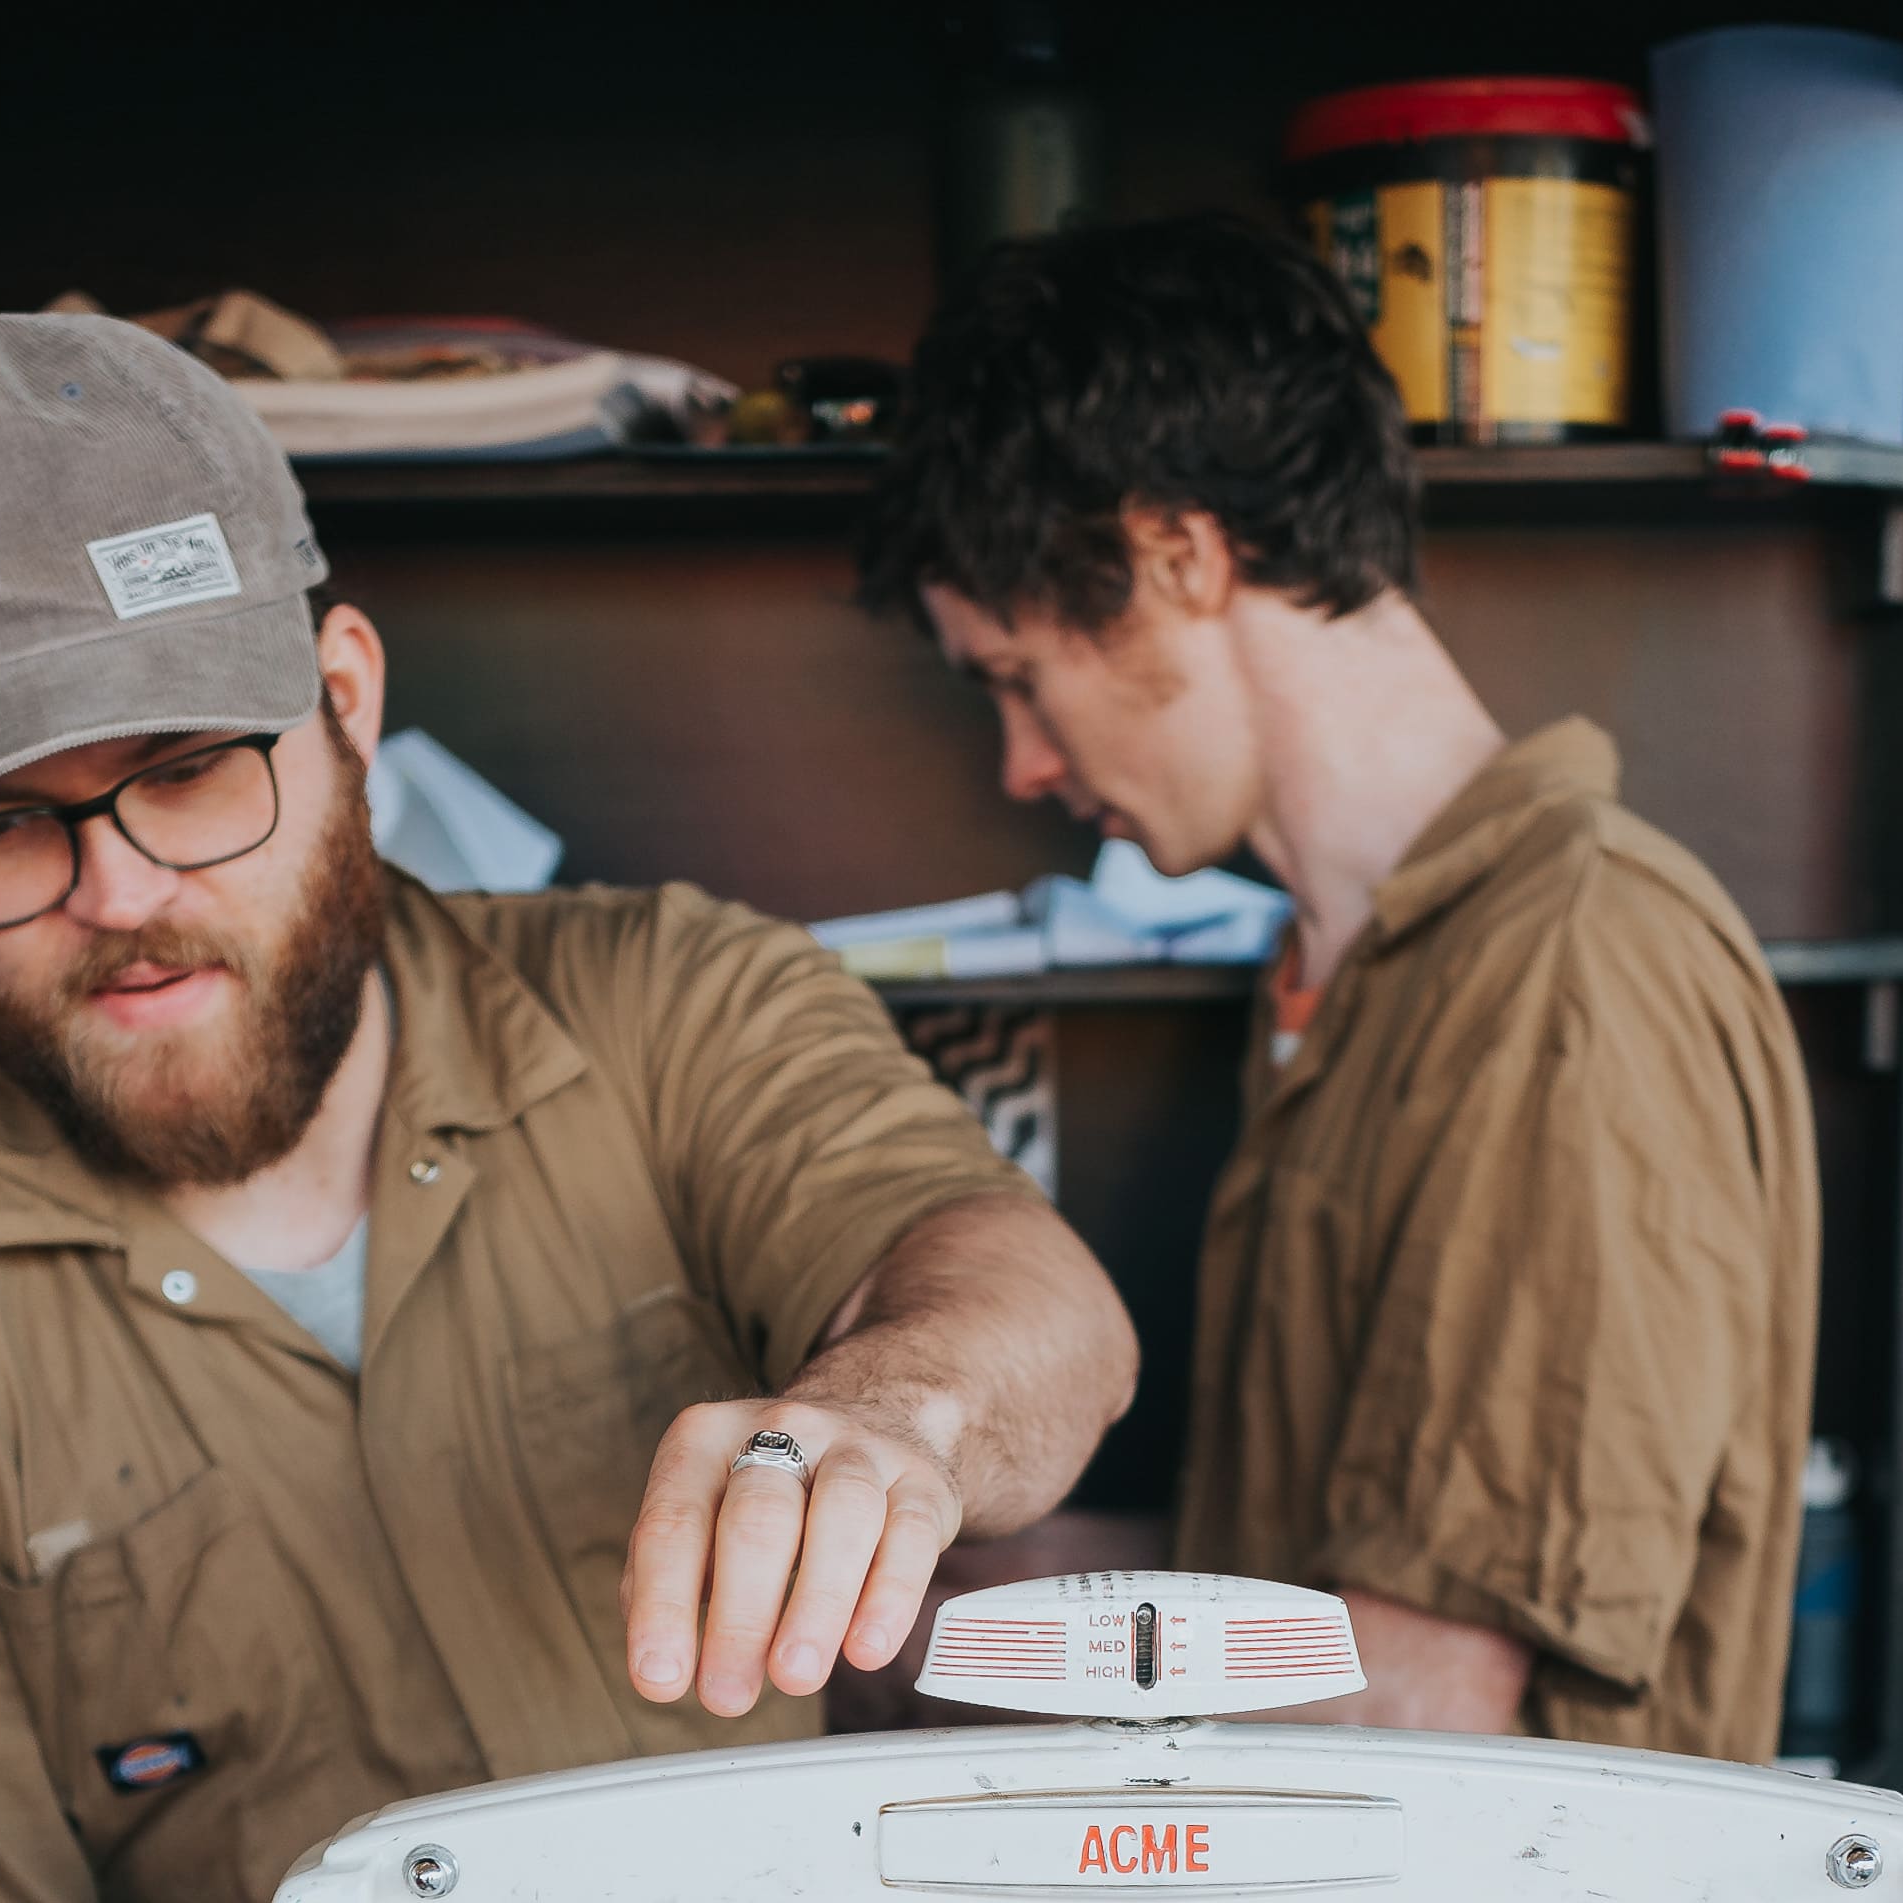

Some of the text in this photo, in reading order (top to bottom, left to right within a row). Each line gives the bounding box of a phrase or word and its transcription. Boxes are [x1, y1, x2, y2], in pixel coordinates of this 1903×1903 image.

[1088, 1613, 1126, 1628] LOW
[1088, 1639, 1126, 1654] MED
[1085, 1665, 1125, 1679] HIGH
[1078, 1823, 1211, 1876] ACME
